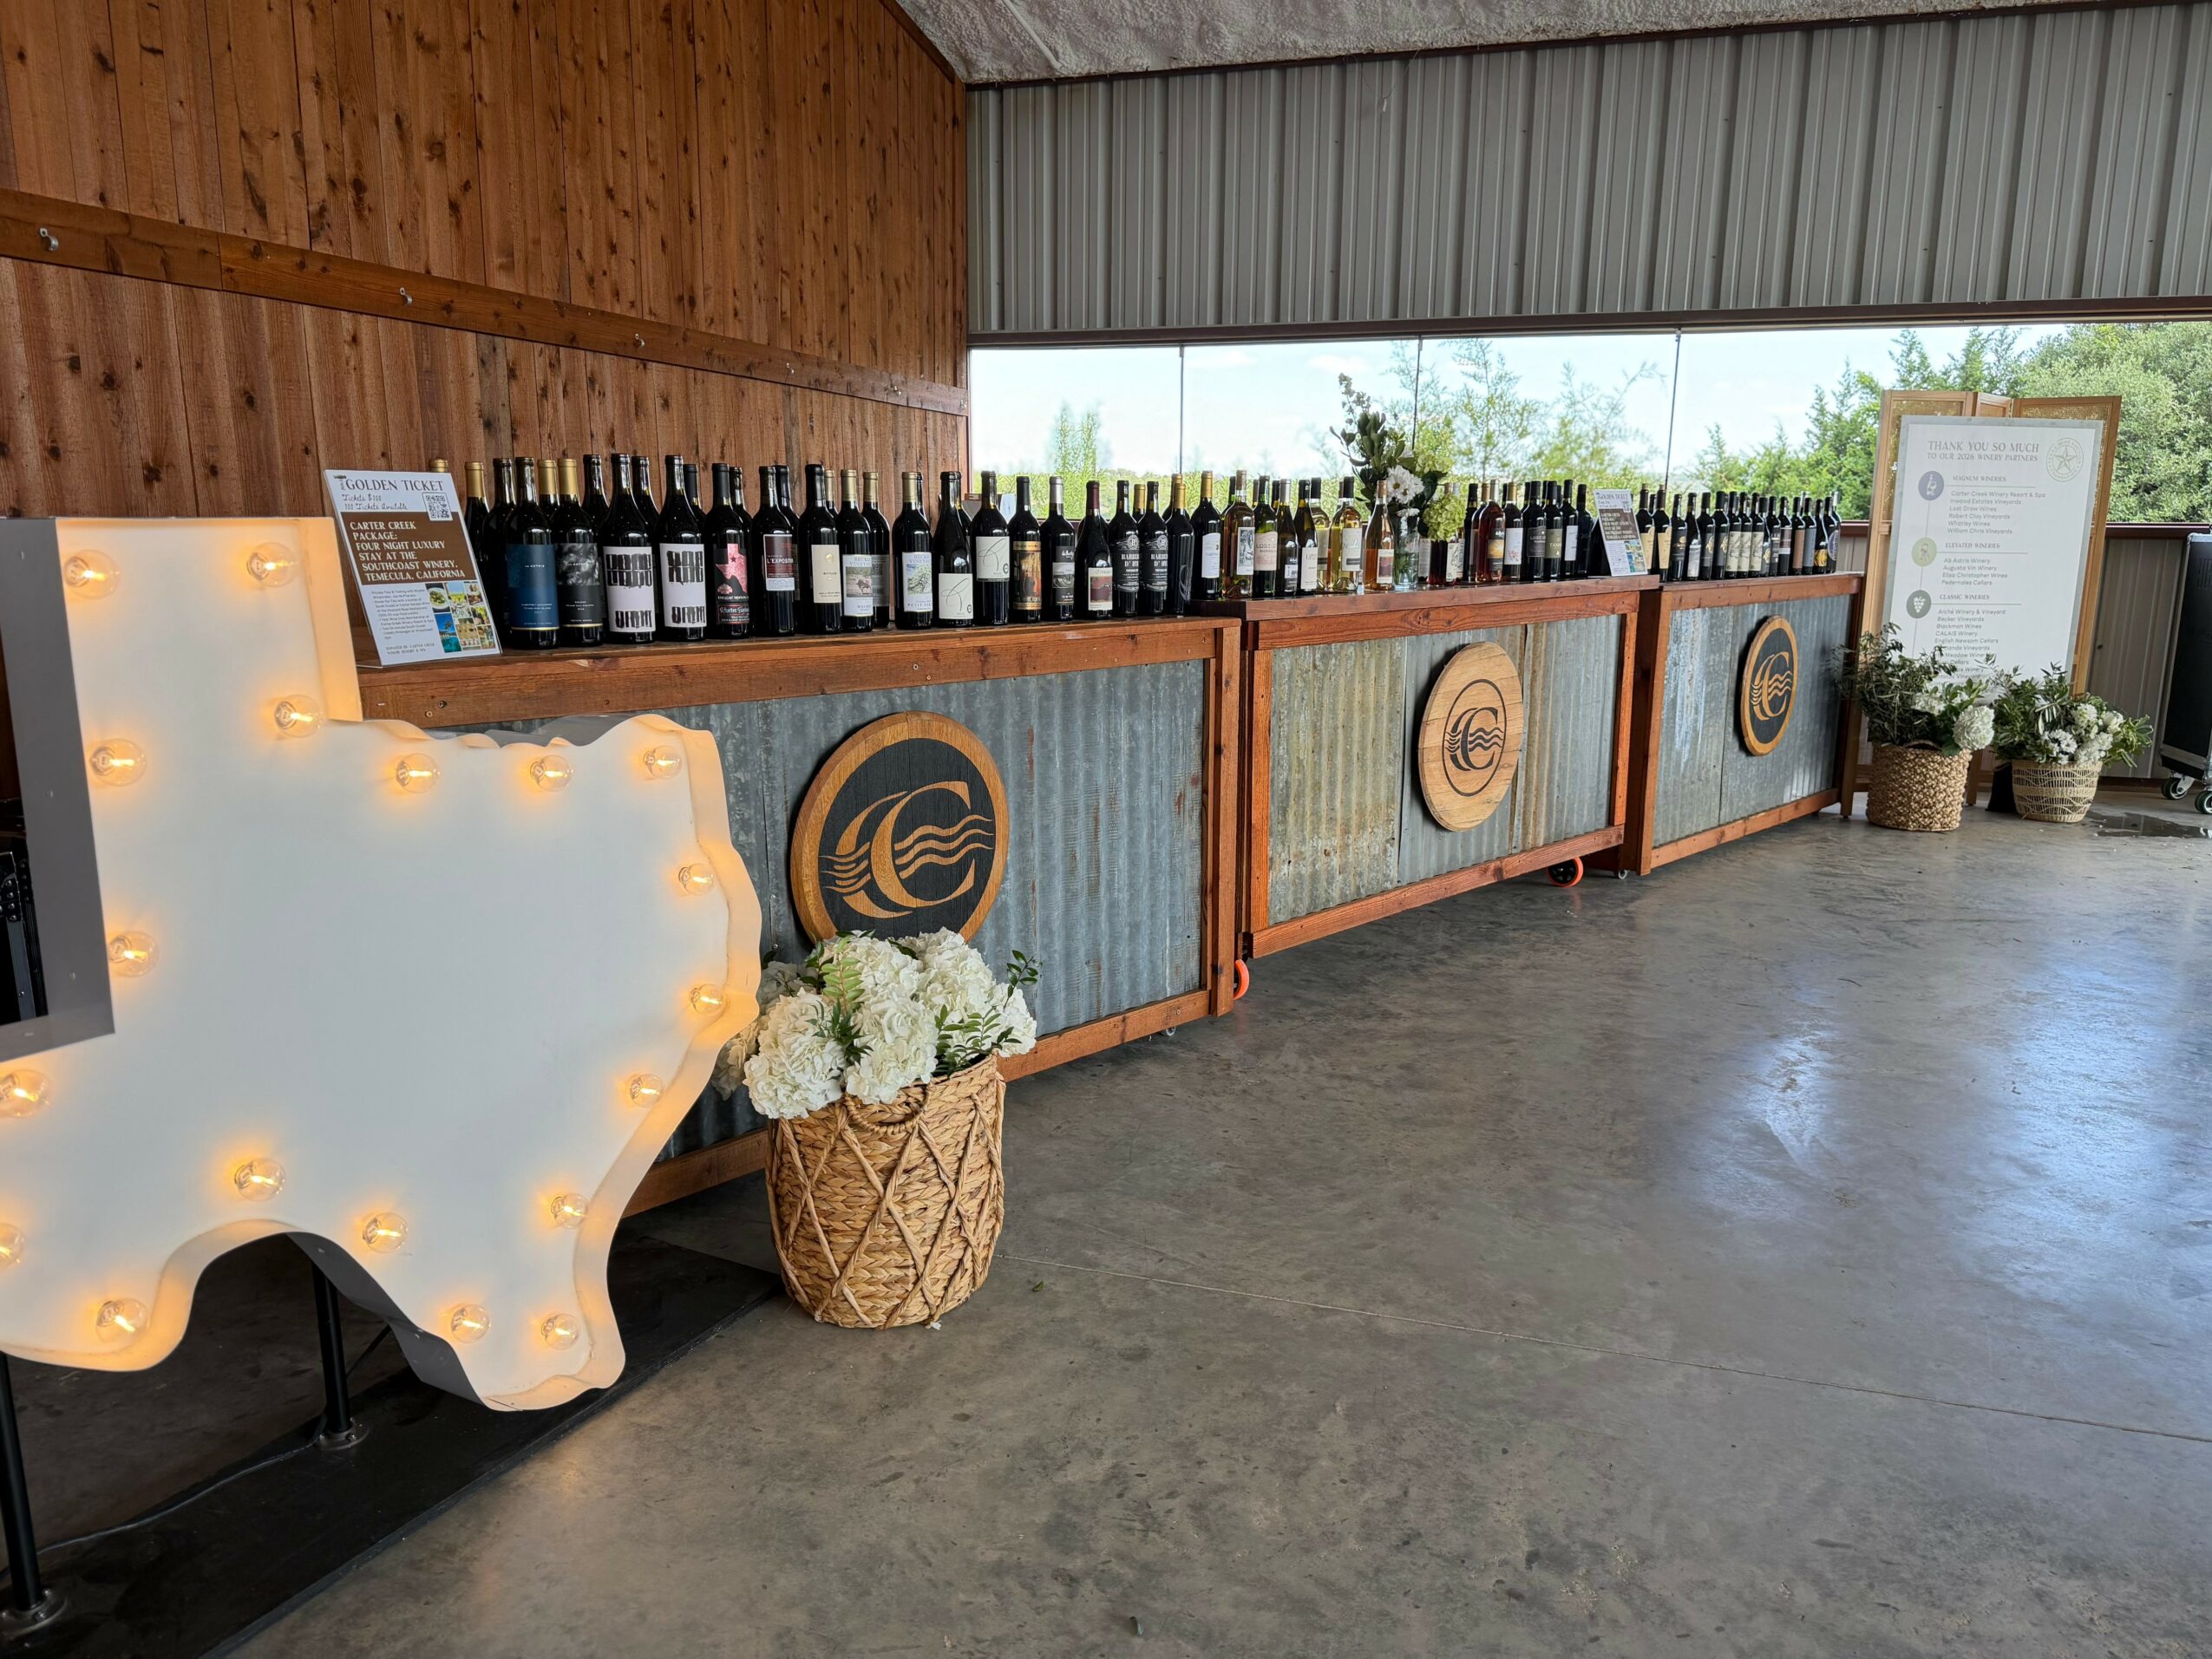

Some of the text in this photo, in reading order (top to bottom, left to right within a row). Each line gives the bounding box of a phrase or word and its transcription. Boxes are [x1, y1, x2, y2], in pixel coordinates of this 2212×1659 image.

[1928, 441, 2039, 453] THANK YOU SO MUCH
[345, 479, 397, 491] GOLDEN
[401, 480, 443, 491] TICKET
[350, 521, 416, 530] CARTER CREEK
[353, 532, 397, 540] PACKAGE:
[356, 542, 381, 551] FOUR
[384, 541, 409, 550] NIGHT
[362, 562, 420, 572] SOUTHCOAST
[416, 570, 465, 579] CALIFORNIA
